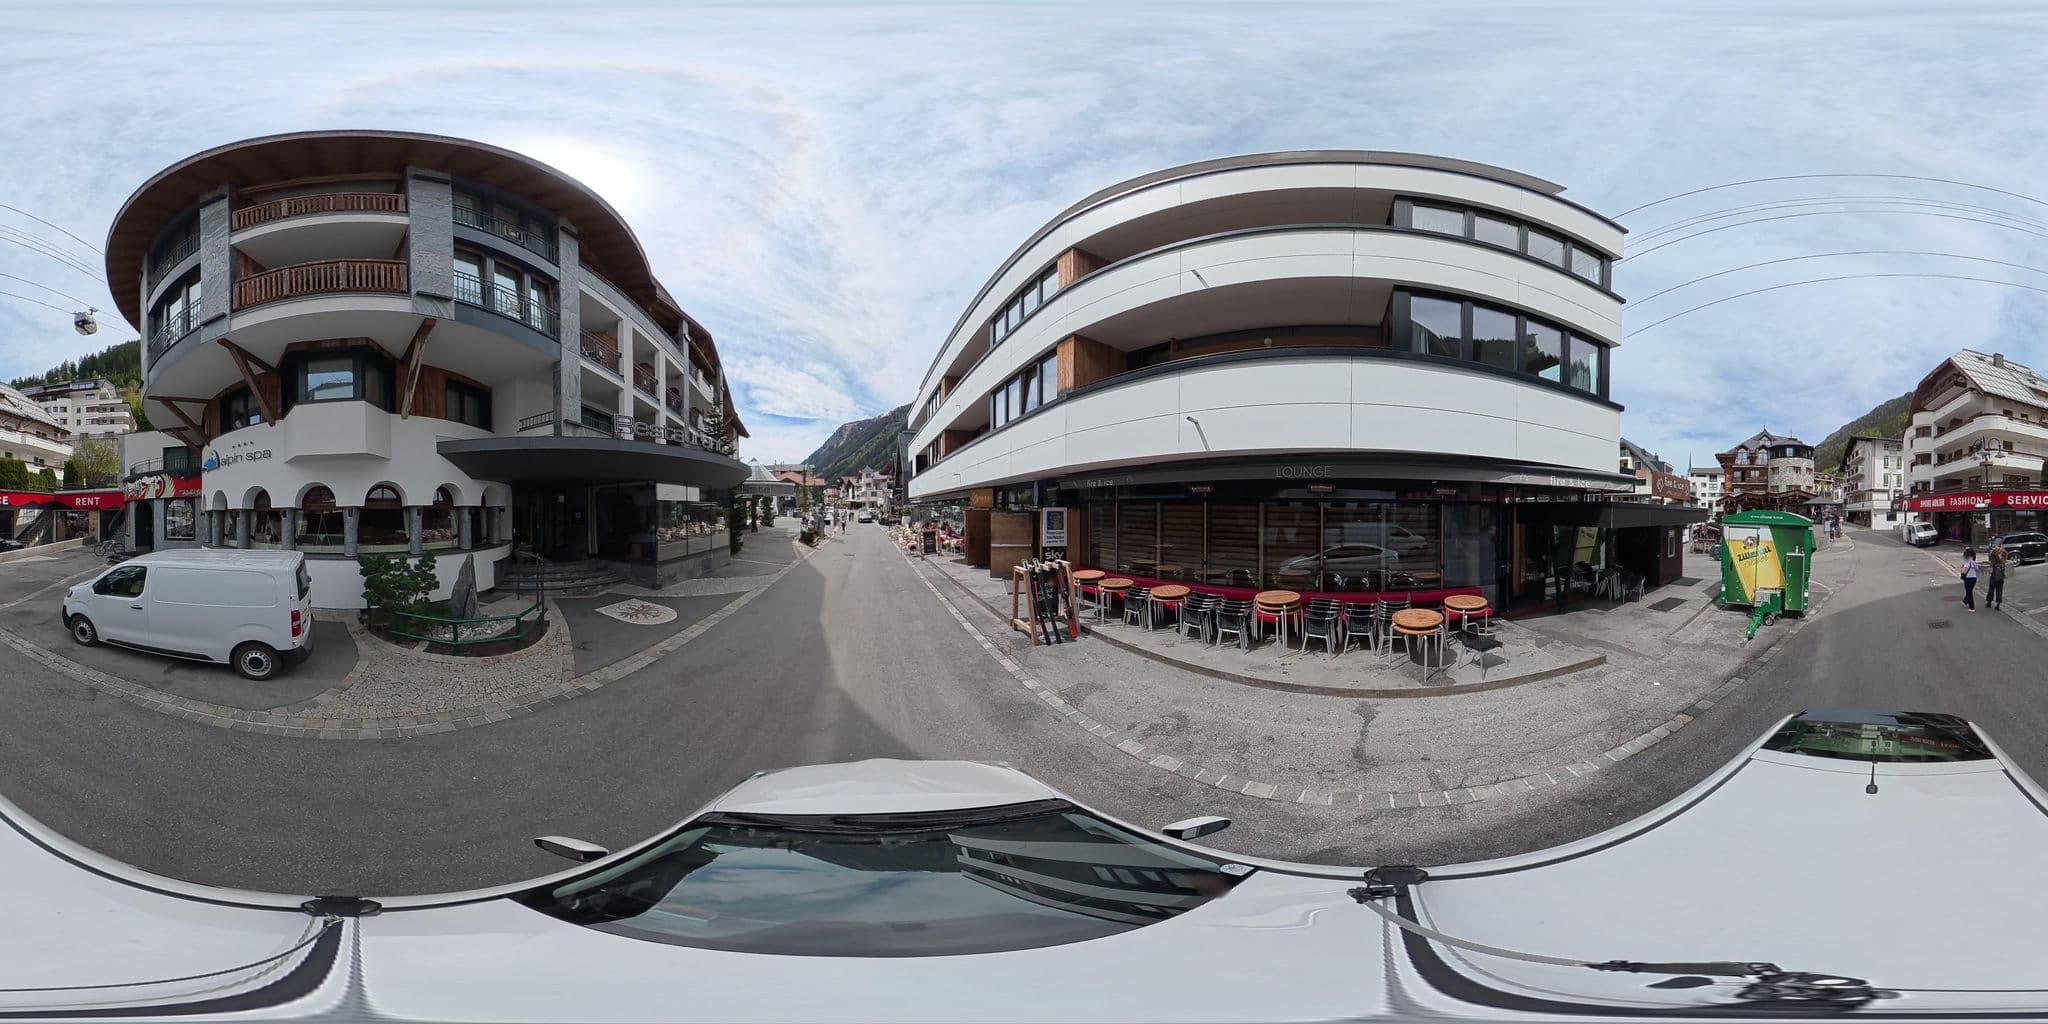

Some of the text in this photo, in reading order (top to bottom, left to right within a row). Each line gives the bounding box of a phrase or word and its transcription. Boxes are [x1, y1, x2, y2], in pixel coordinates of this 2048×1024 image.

[245, 449, 271, 462] spa
[1276, 465, 1332, 478] LOUNGE
[1550, 476, 1566, 487] fire
[75, 496, 100, 506] RENT
[1950, 496, 1983, 506] FASHION
[1045, 549, 1063, 560] sky
